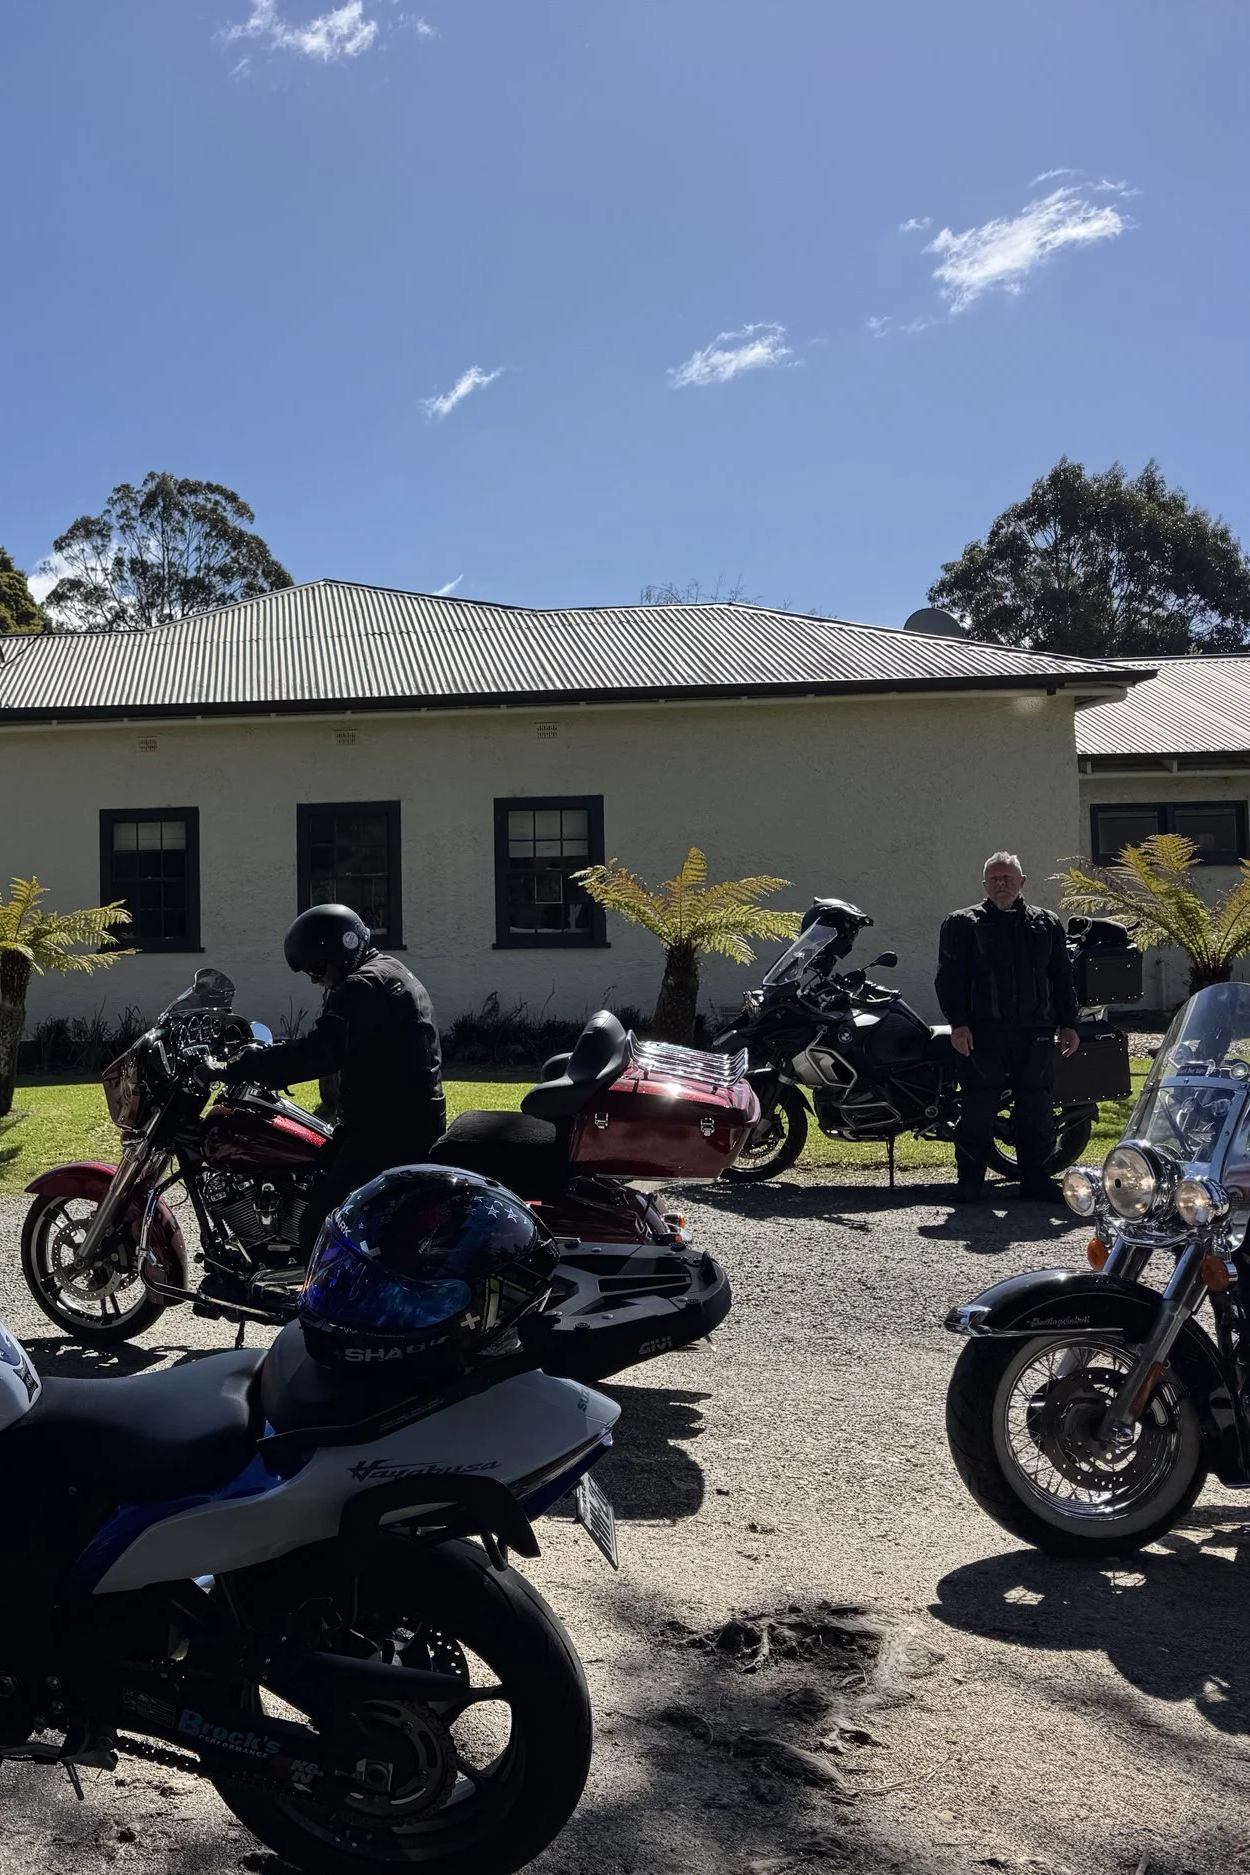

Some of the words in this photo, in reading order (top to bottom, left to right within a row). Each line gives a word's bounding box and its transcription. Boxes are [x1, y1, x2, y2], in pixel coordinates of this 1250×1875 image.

[639, 1335, 673, 1355] GIVI
[177, 1708, 282, 1755] Brock's
[197, 1734, 270, 1760] PERFORMANCE
